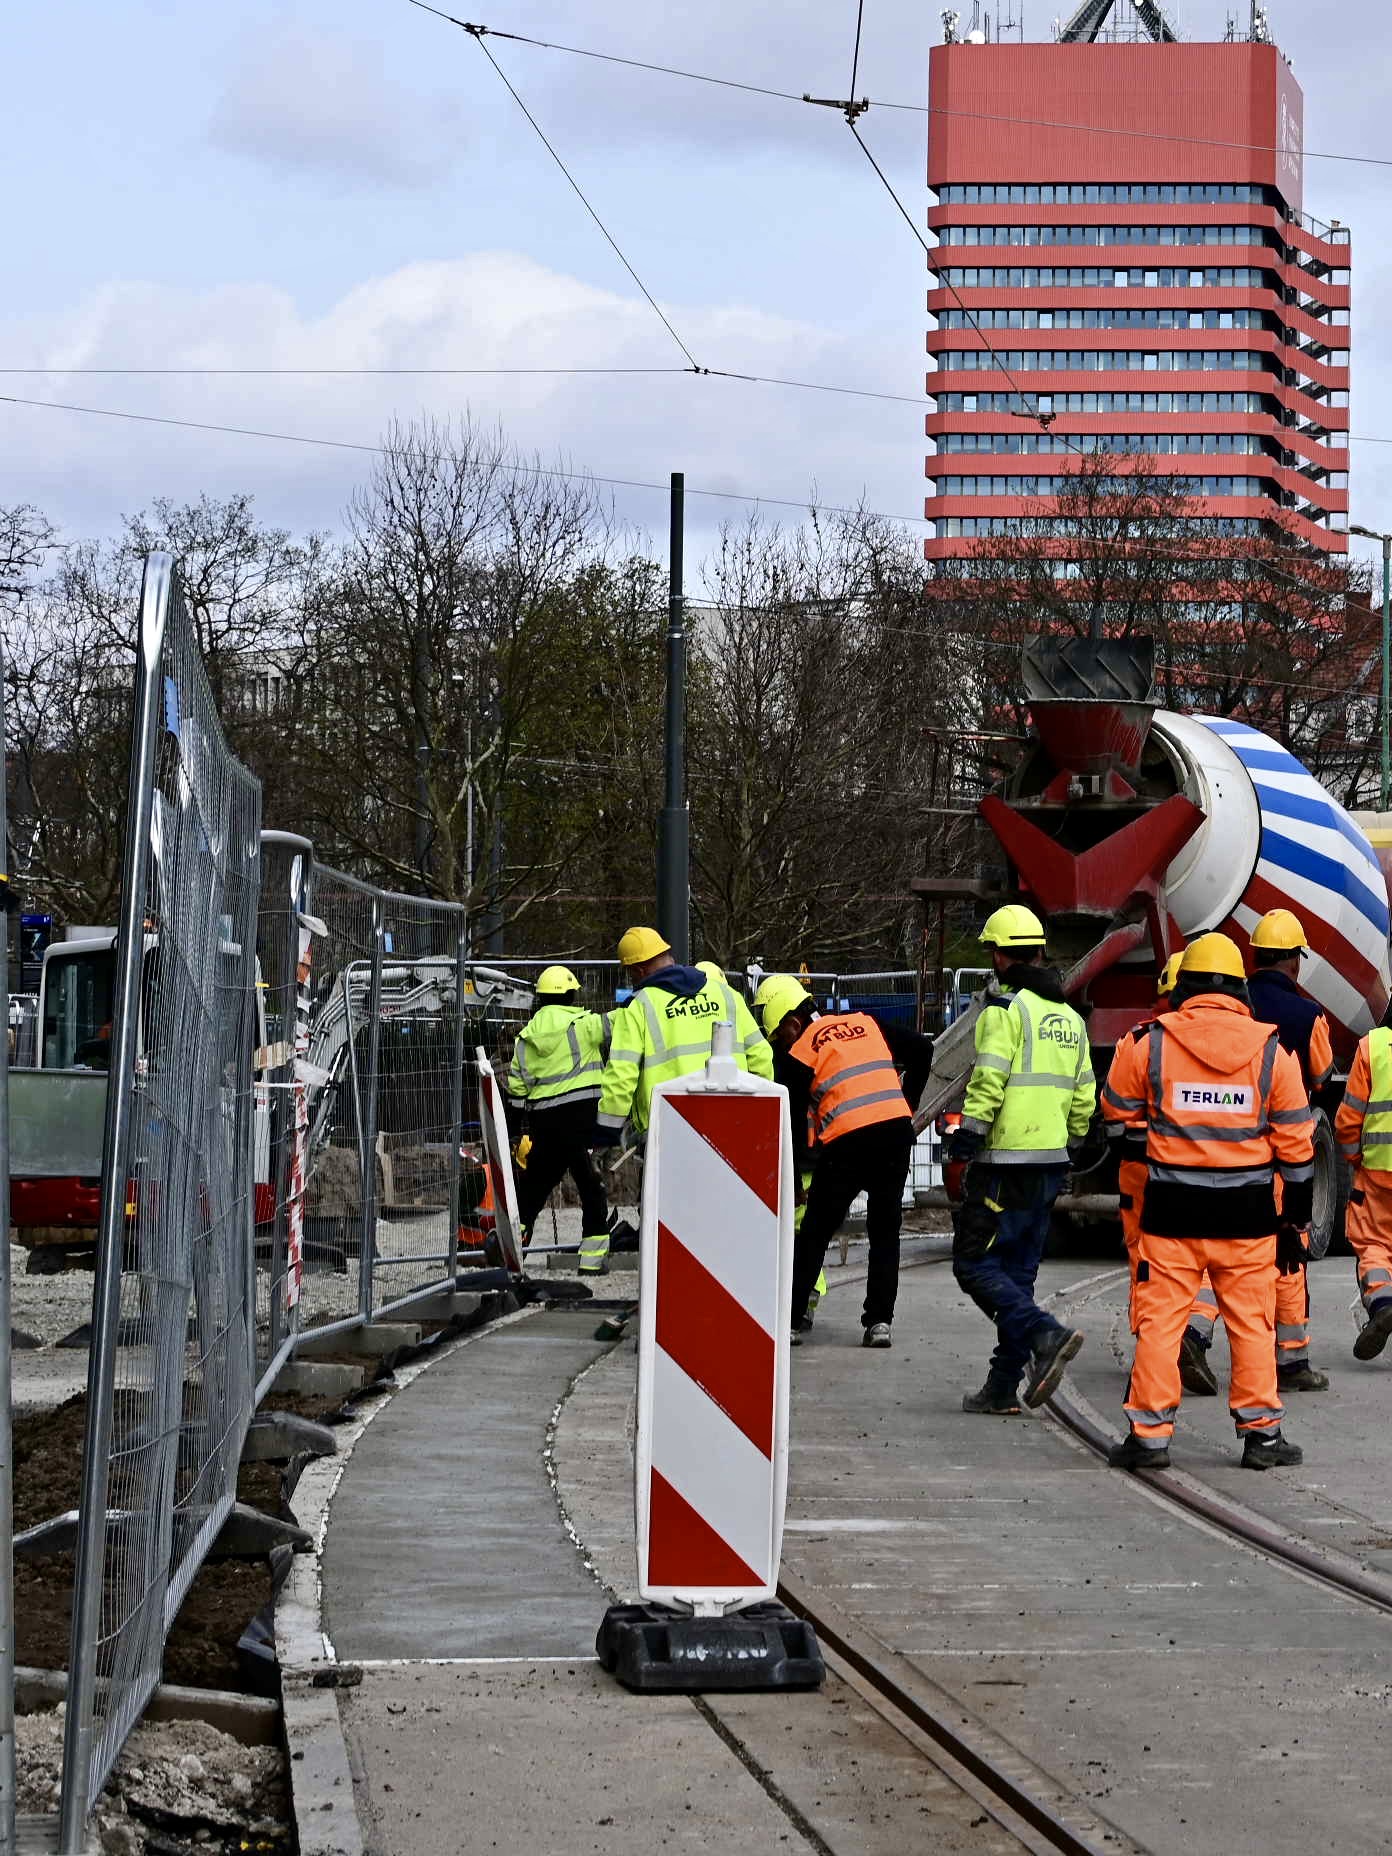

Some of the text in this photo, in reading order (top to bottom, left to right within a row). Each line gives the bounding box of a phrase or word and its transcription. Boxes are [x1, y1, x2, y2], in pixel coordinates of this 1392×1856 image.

[665, 1006, 687, 1019] EM
[689, 1001, 720, 1016] BUD
[833, 1026, 865, 1040] BUD
[1038, 1026, 1079, 1045] EM BUD
[1181, 1090, 1245, 1105] TERLAN
